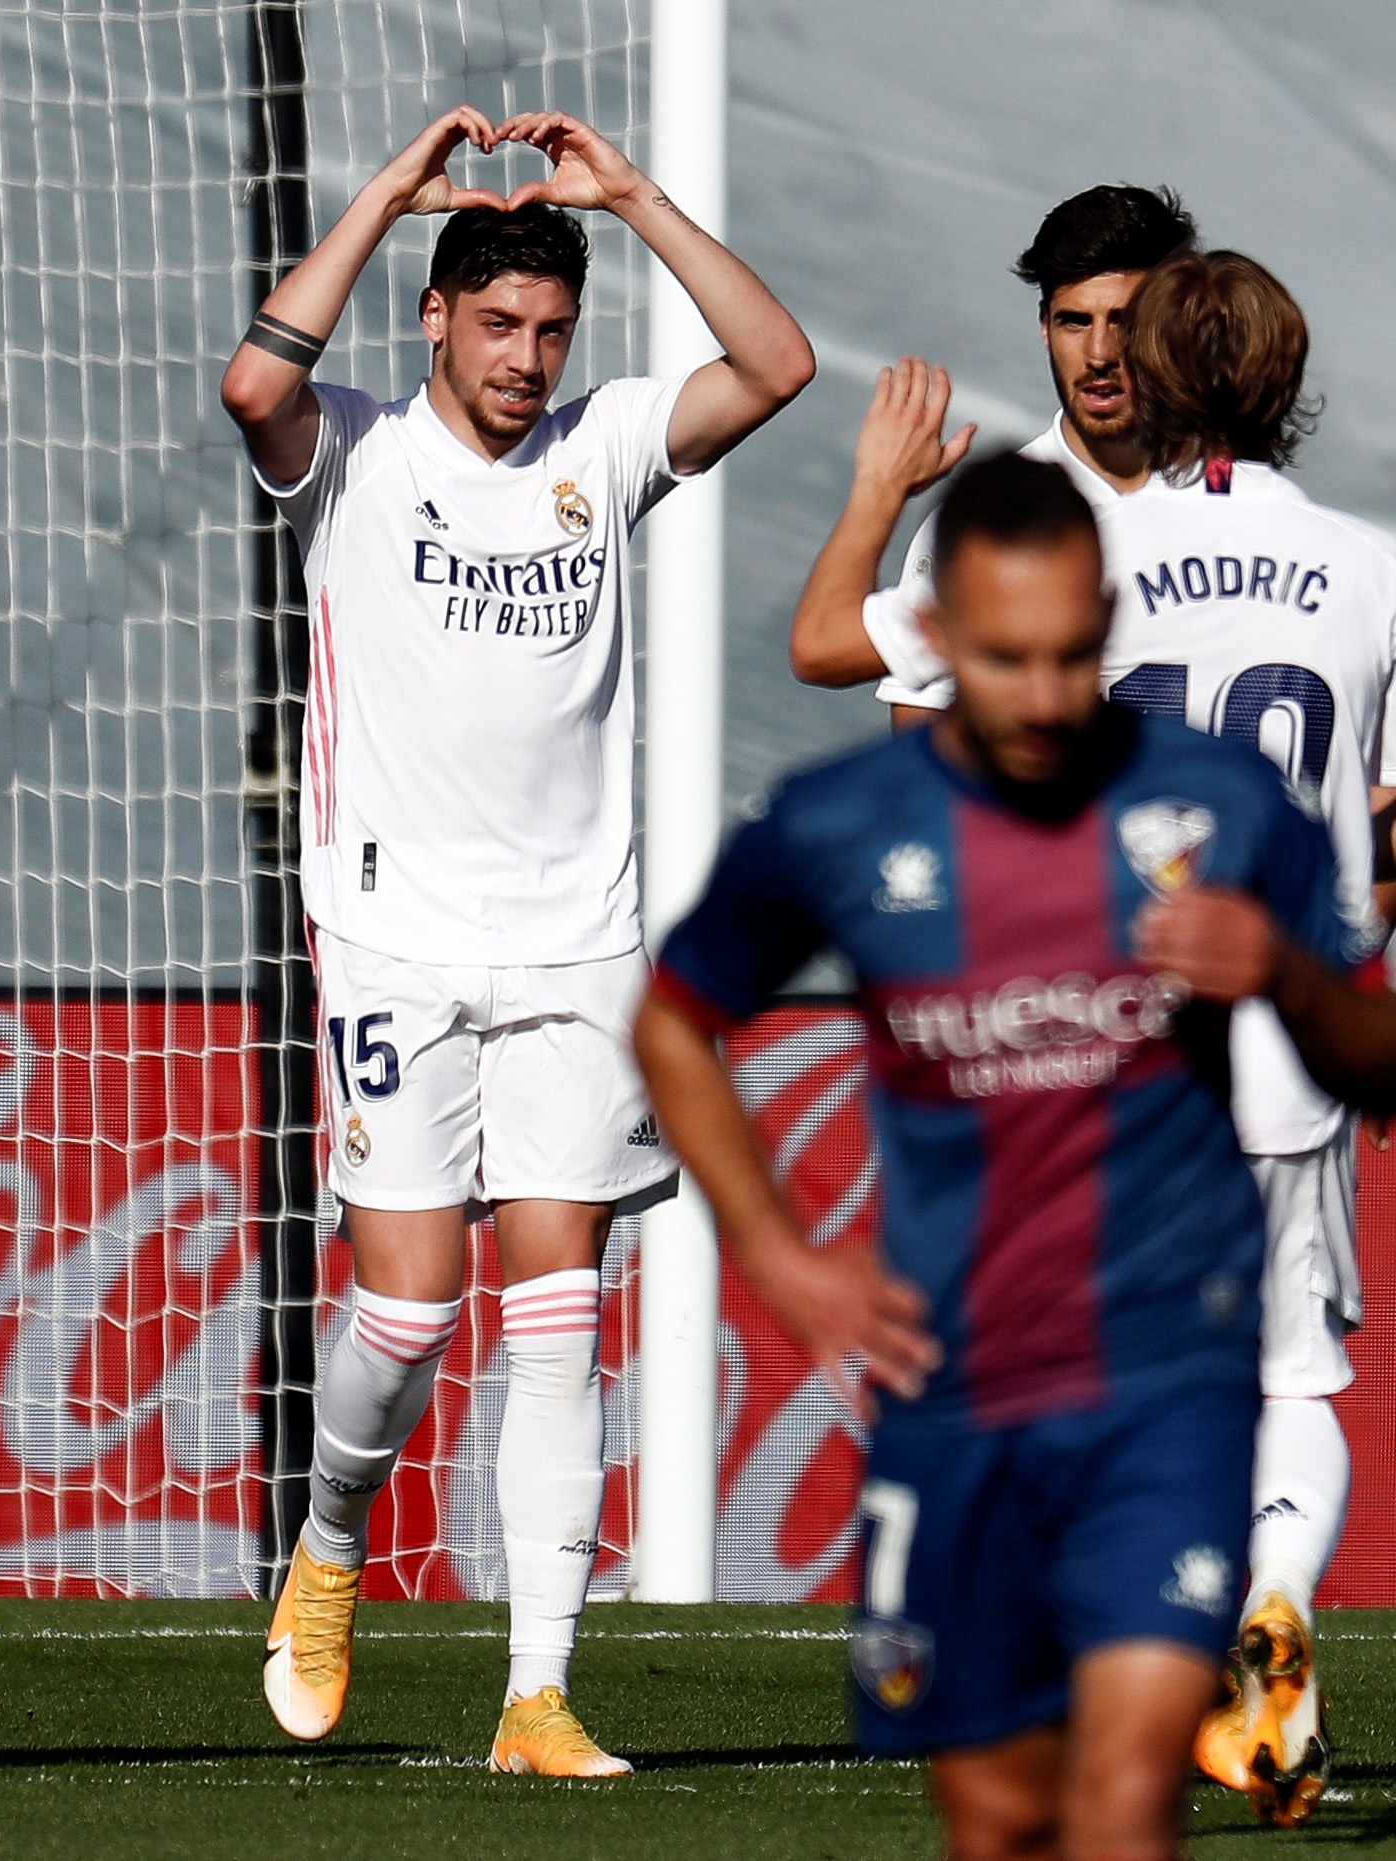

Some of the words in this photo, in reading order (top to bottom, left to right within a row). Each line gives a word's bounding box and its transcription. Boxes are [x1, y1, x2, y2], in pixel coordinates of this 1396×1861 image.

[414, 539, 605, 598] Emirates
[1134, 555, 1330, 617] MODRIĆ
[444, 596, 489, 632] FLY
[496, 599, 588, 636] BETTER
[327, 1011, 401, 1108] 15
